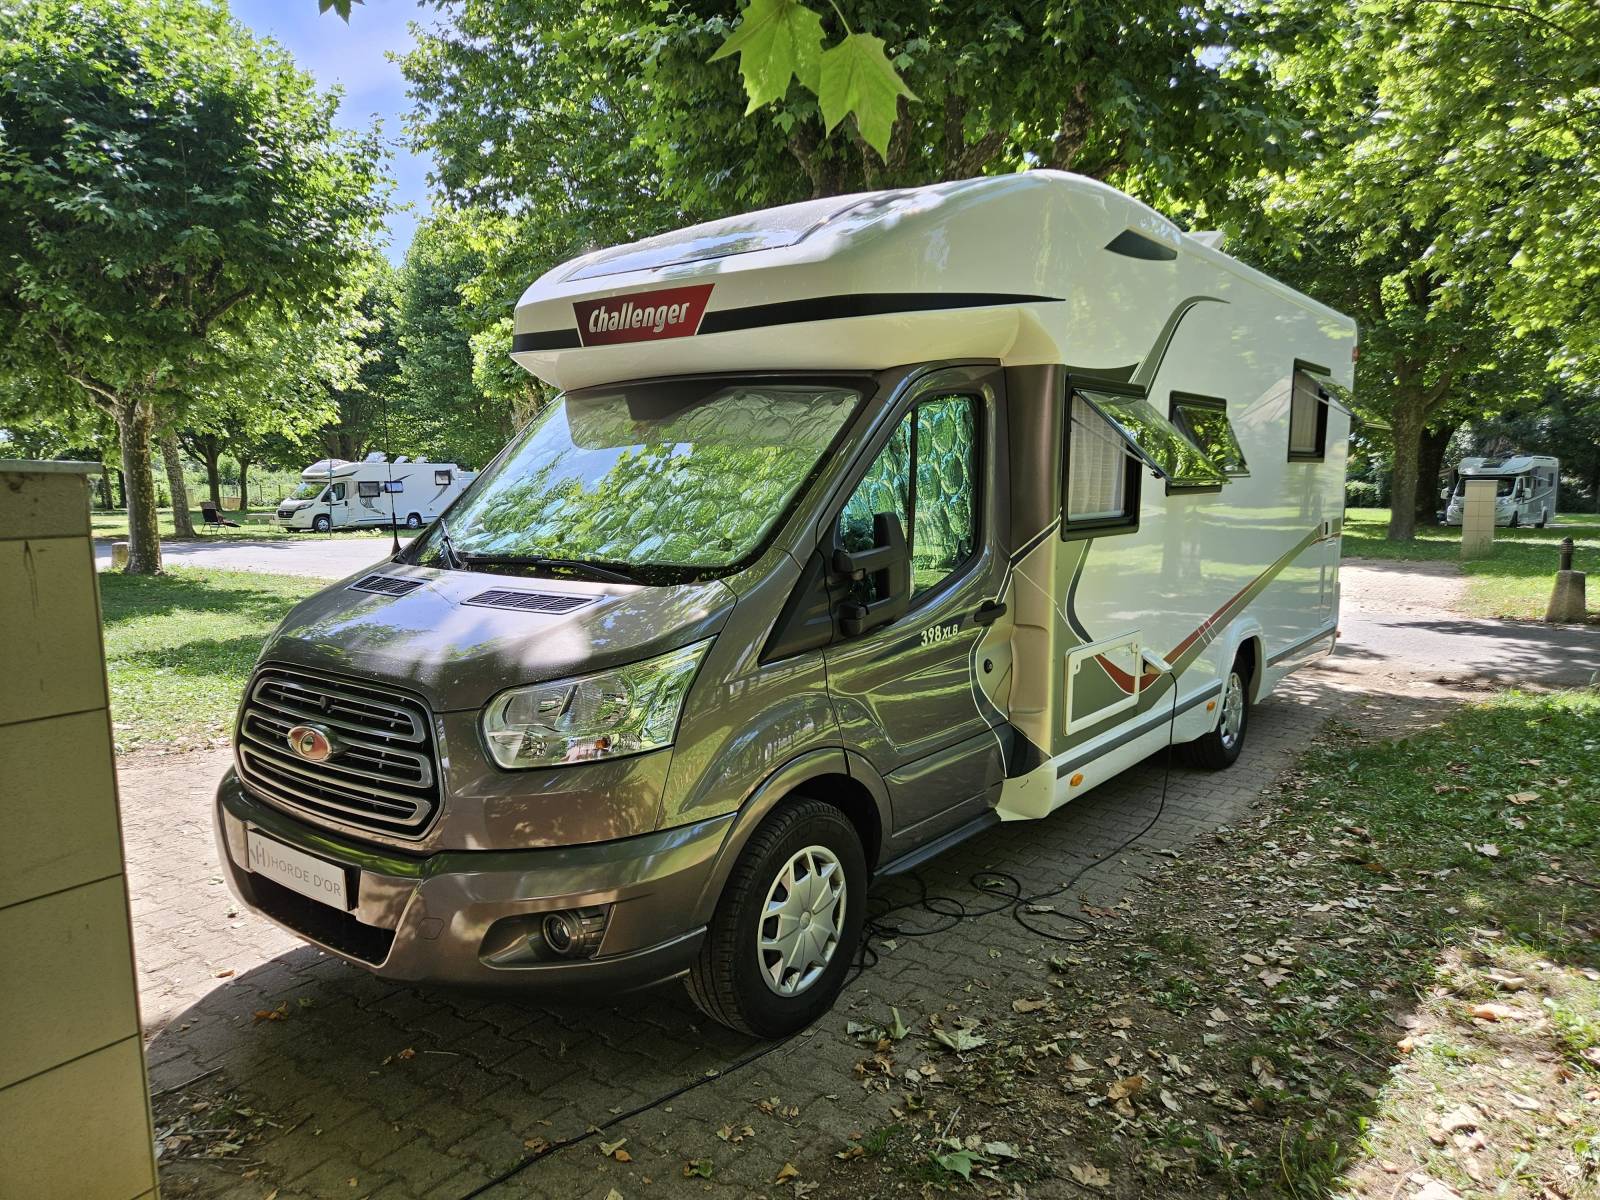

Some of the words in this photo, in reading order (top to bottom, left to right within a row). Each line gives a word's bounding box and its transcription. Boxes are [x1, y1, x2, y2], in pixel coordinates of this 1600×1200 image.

[588, 302, 690, 333] Challenger
[271, 856, 310, 883] HORDE
[313, 874, 342, 897] D'OR
